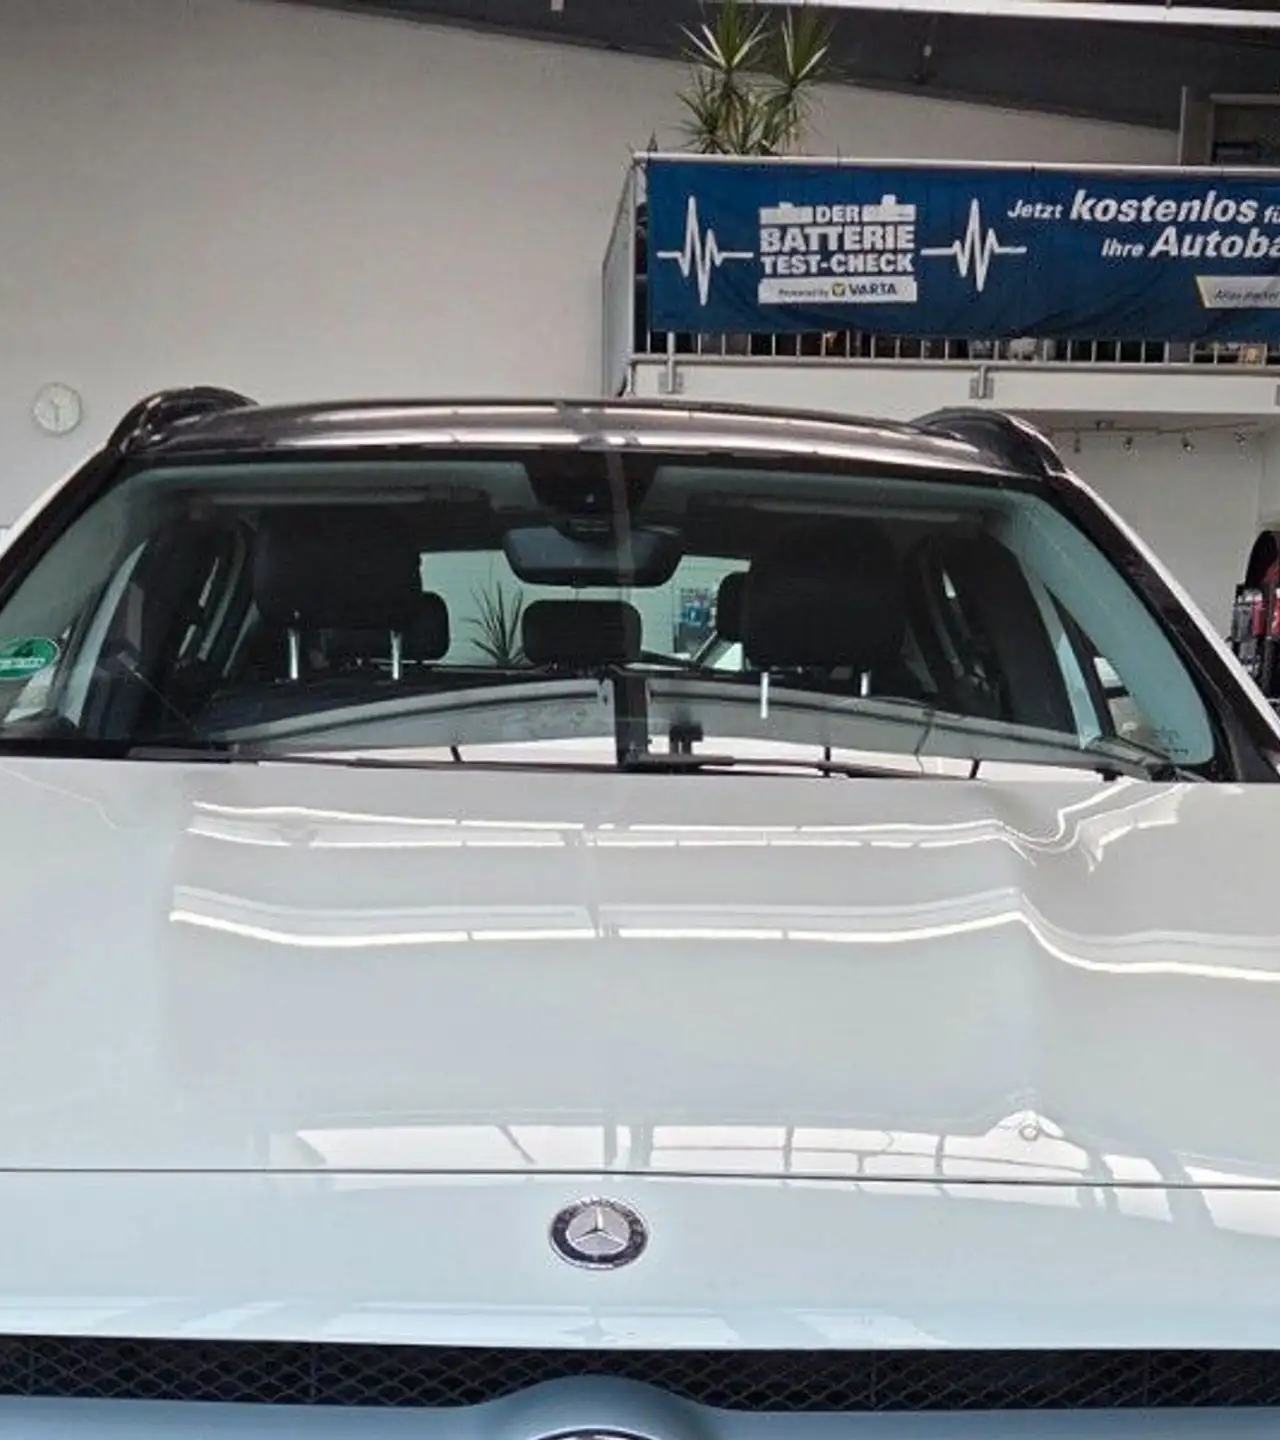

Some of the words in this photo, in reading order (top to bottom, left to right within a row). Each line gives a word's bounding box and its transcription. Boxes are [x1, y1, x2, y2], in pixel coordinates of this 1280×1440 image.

[815, 205, 860, 224] DER
[1007, 199, 1064, 219] Jetzt
[1070, 188, 1260, 224] kostenlos
[759, 224, 915, 253] BATTERIE
[1101, 237, 1146, 258] Ihre
[760, 251, 915, 275] TEST-CHECK
[848, 282, 898, 296] VARTA
